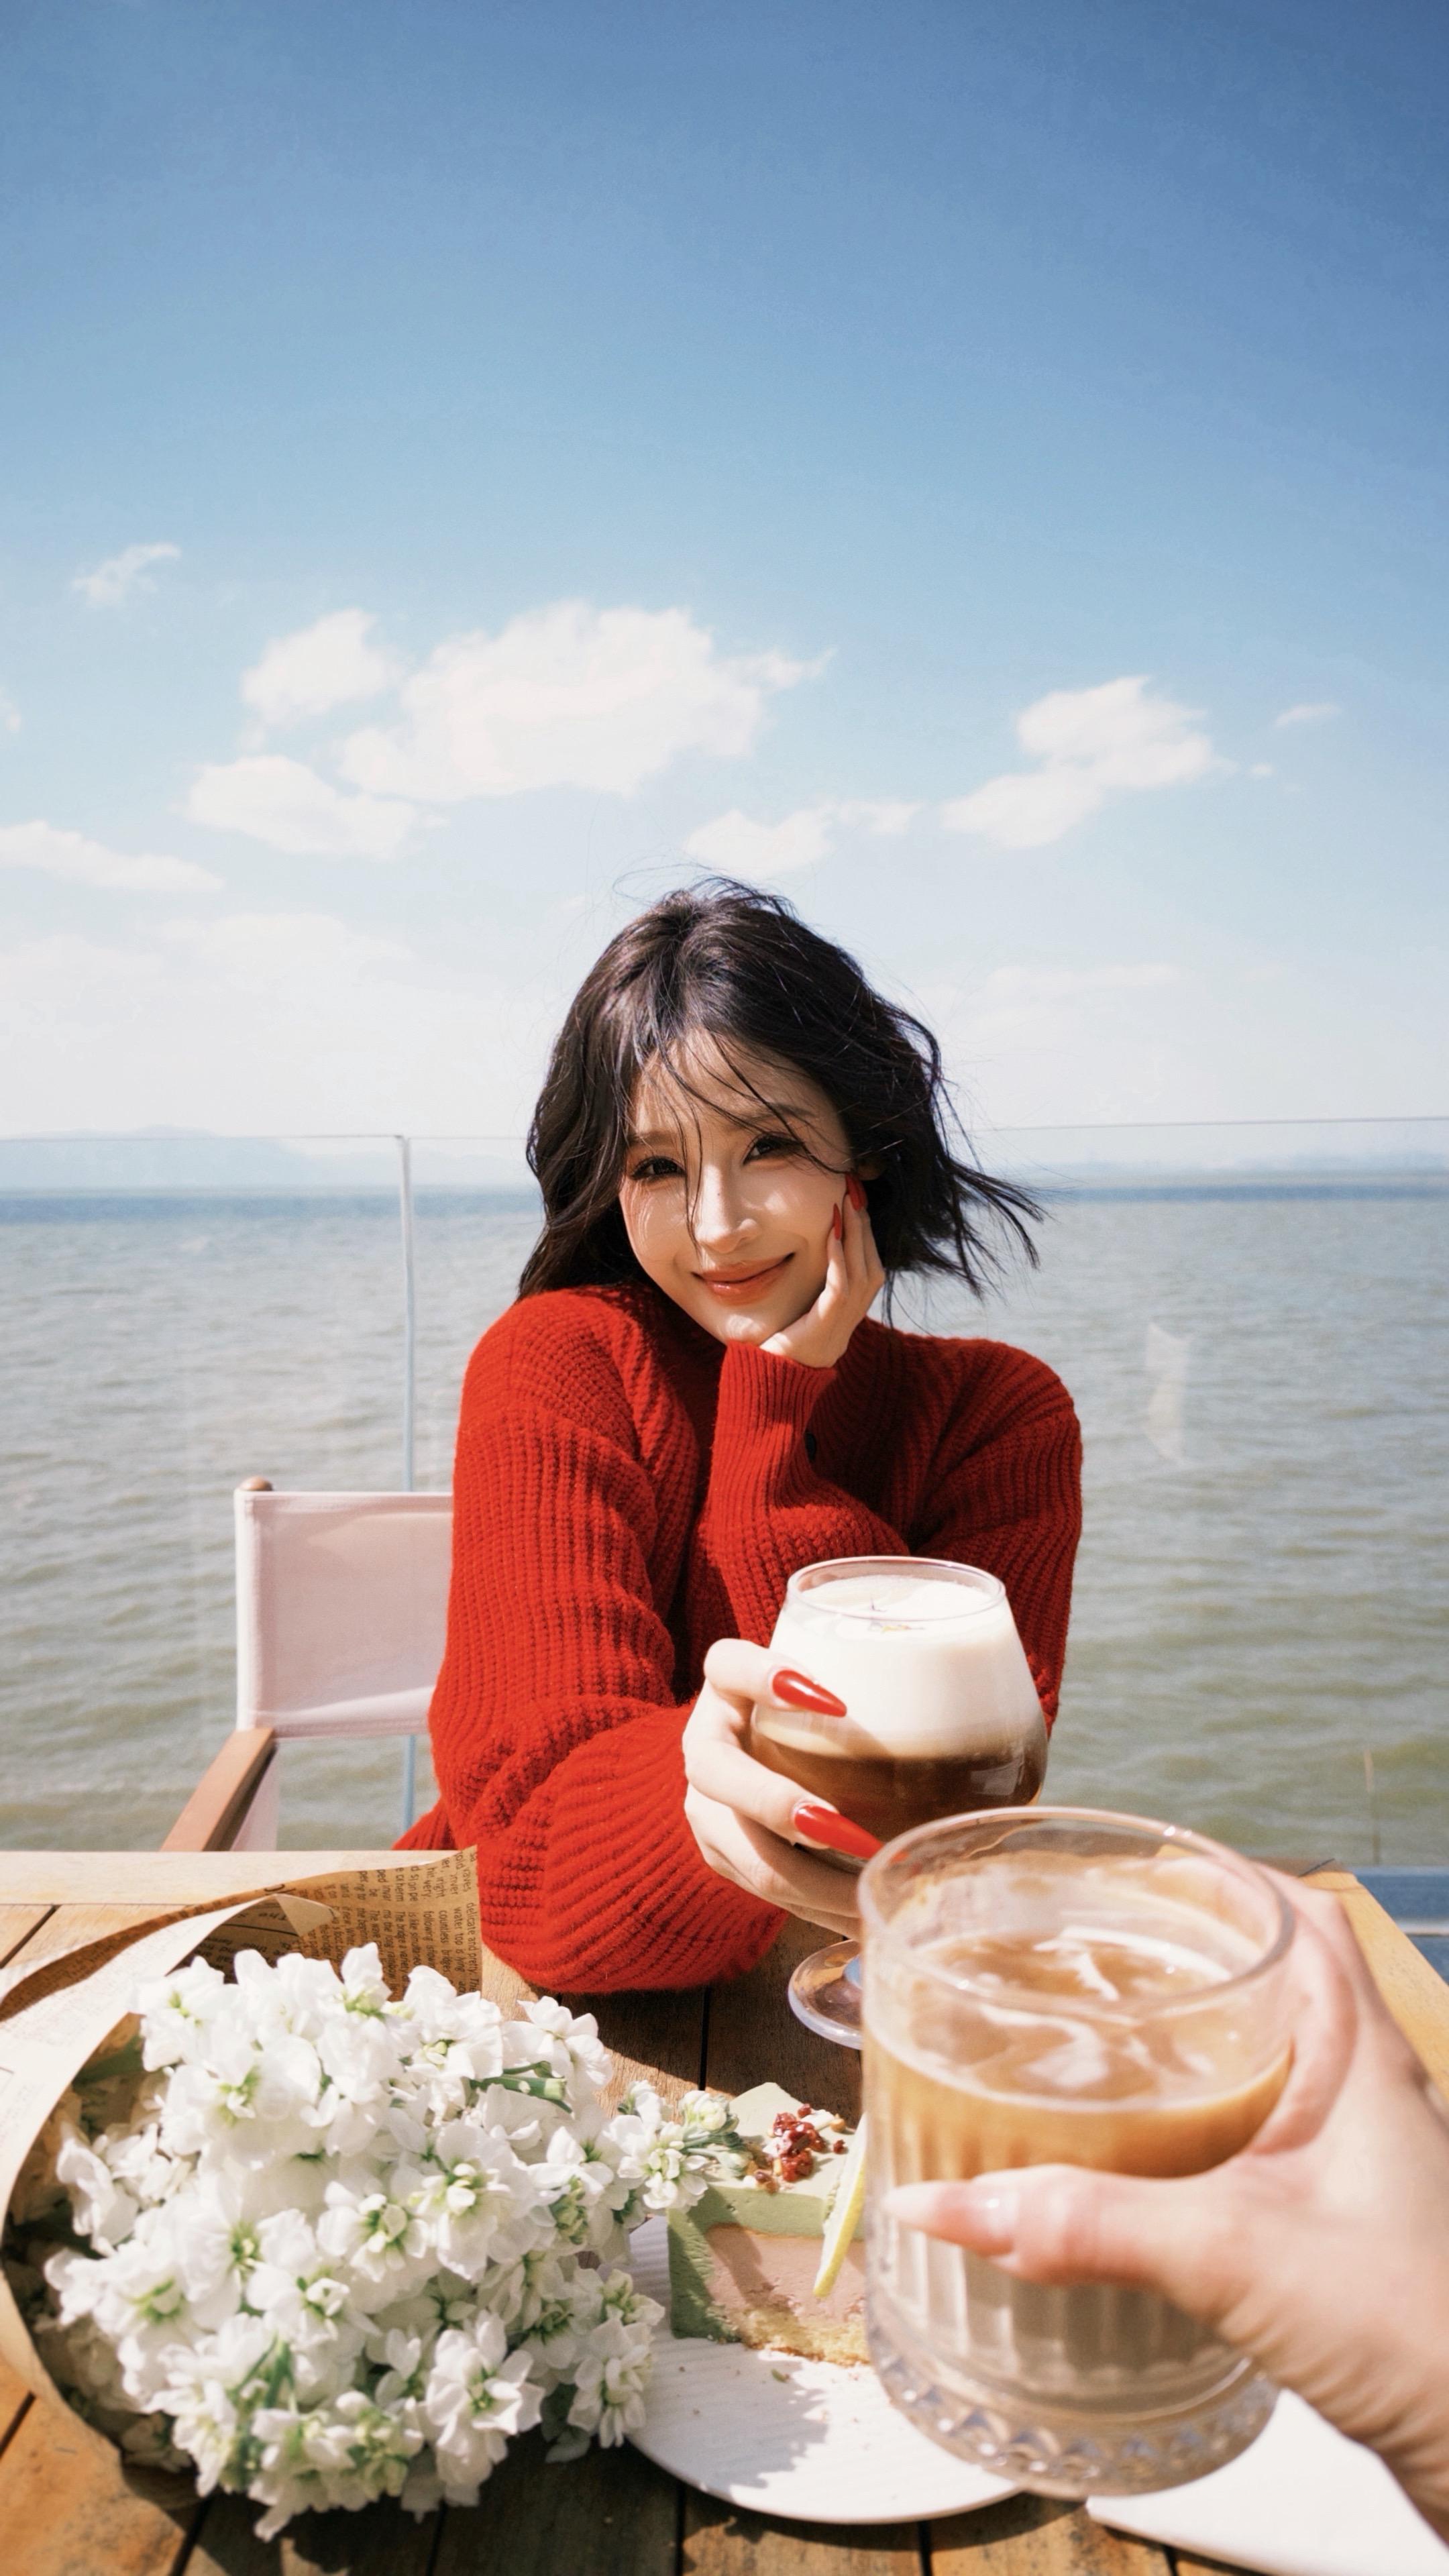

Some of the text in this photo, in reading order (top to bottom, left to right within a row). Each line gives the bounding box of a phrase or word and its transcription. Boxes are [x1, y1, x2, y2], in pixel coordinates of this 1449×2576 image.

[439, 1910, 451, 1943] countless
[454, 1907, 464, 1929] water
[466, 1902, 478, 1935] delicate
[454, 1933, 464, 1945] top
[468, 1938, 478, 1951] and
